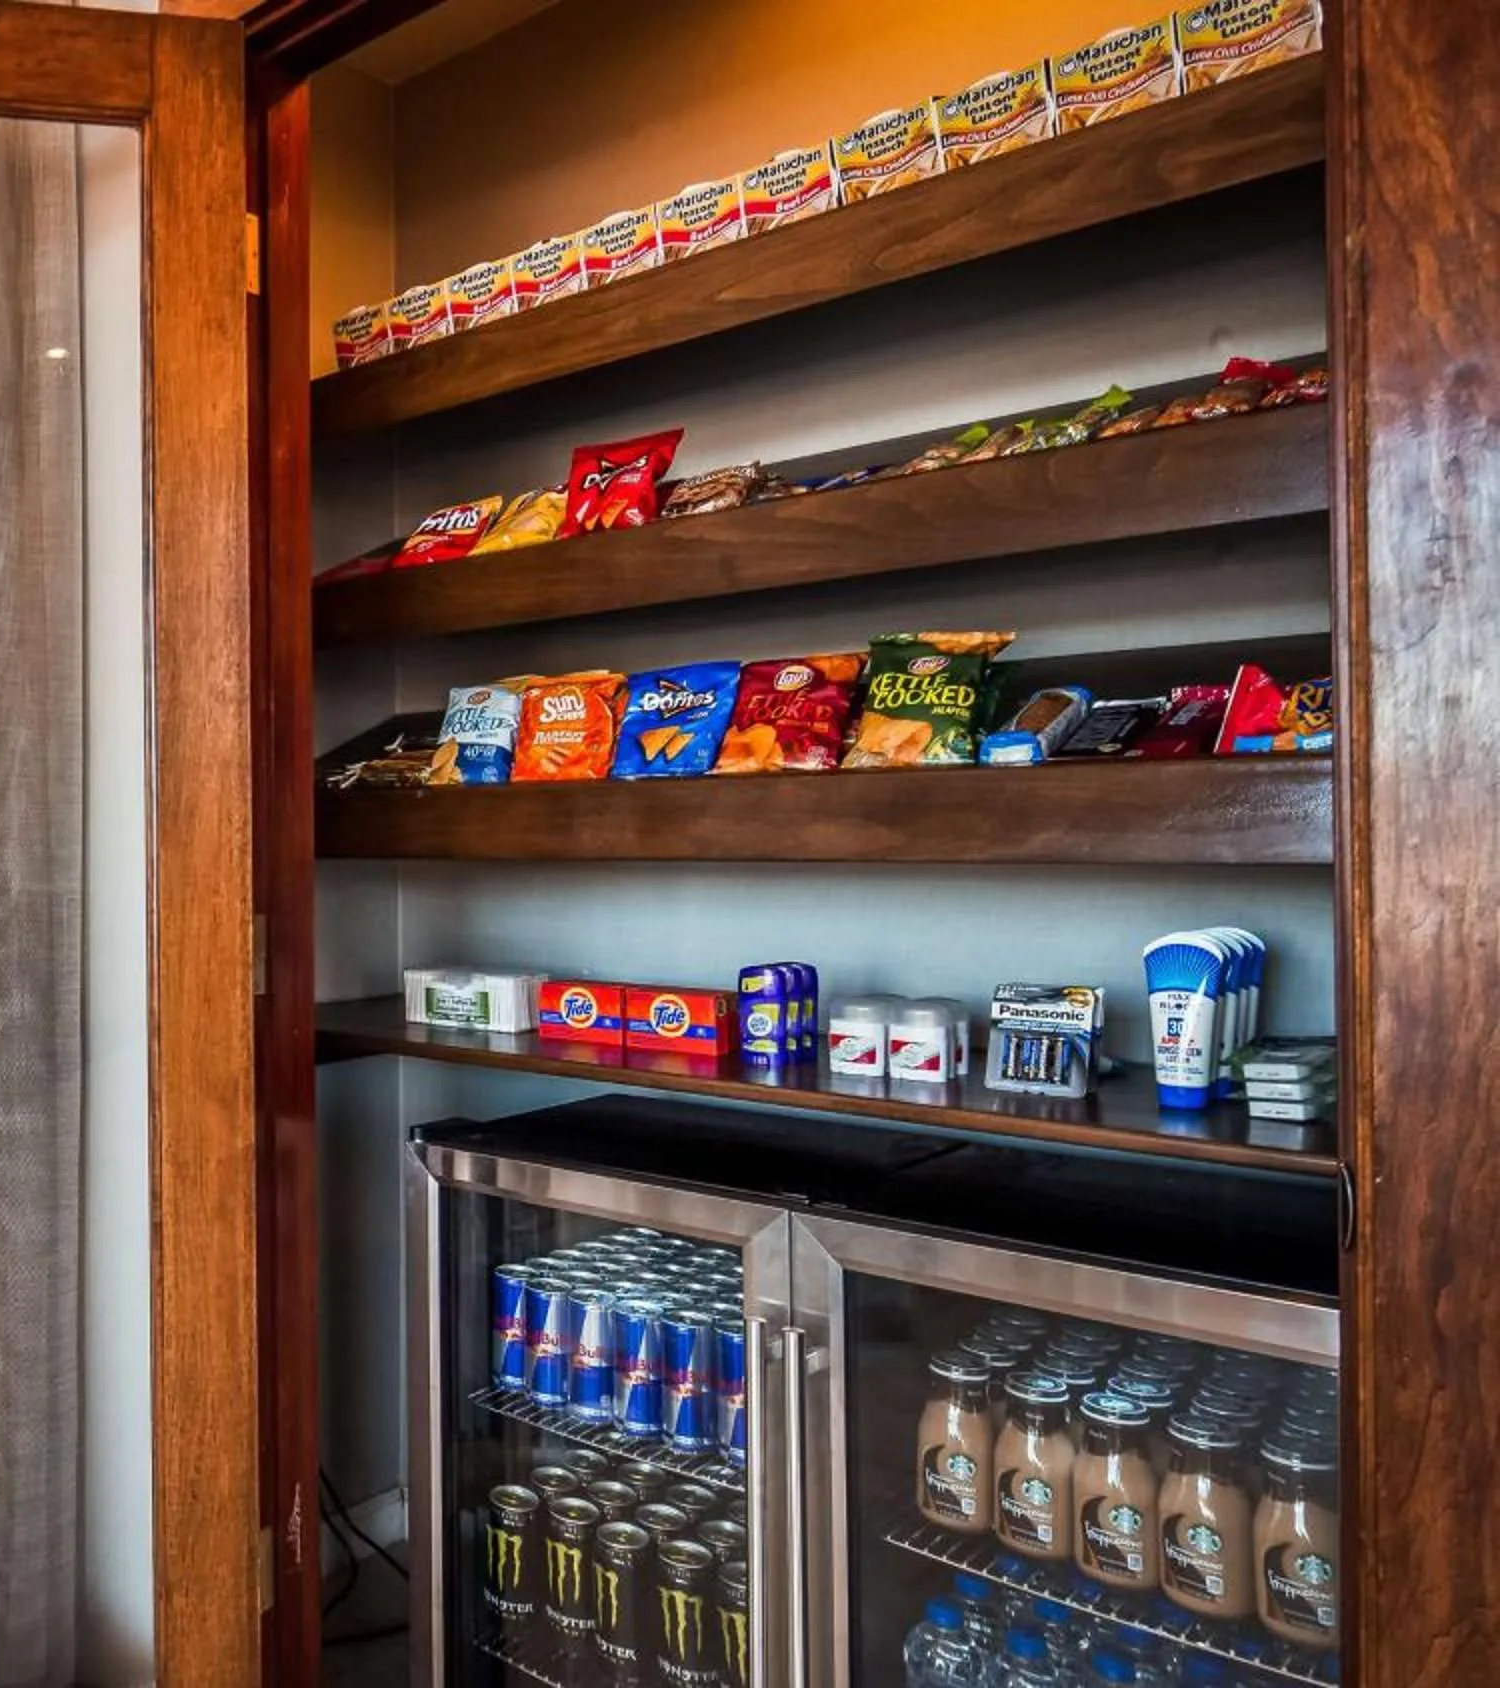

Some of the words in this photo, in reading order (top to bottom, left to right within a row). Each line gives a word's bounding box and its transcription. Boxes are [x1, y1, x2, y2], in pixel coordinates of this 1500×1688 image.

[1213, 0, 1277, 30] Instant
[1222, 13, 1273, 38] Lunch
[1075, 25, 1162, 62] Maruchan
[1185, 50, 1213, 63] Lime
[1214, 46, 1239, 58] Chili
[1241, 28, 1281, 53] Chicken
[1084, 46, 1141, 75] Instant
[1090, 62, 1137, 83] Lunch
[957, 69, 1035, 106] Maruchan
[964, 91, 1017, 117] Instant
[971, 104, 1013, 125] Lunch
[854, 106, 925, 144] Maruchan
[861, 127, 908, 152] Instant
[867, 140, 905, 161] Lunch
[757, 150, 822, 180] Maruchan
[763, 168, 807, 190] Instant
[769, 180, 804, 197] Lunch
[673, 183, 733, 209] Maruchan
[679, 201, 719, 220] Instant
[683, 212, 716, 227] Lunch
[594, 212, 649, 238] Maruchan
[600, 228, 637, 247] Instant
[605, 238, 635, 255] Lunch
[524, 239, 573, 262] Maruchan
[869, 672, 950, 696] KETTLE
[642, 689, 715, 711] Doritos
[873, 685, 975, 710] COOKED
[564, 997, 593, 1019] Tide
[654, 1005, 686, 1029] Tide
[999, 1004, 1085, 1021] Panasonic
